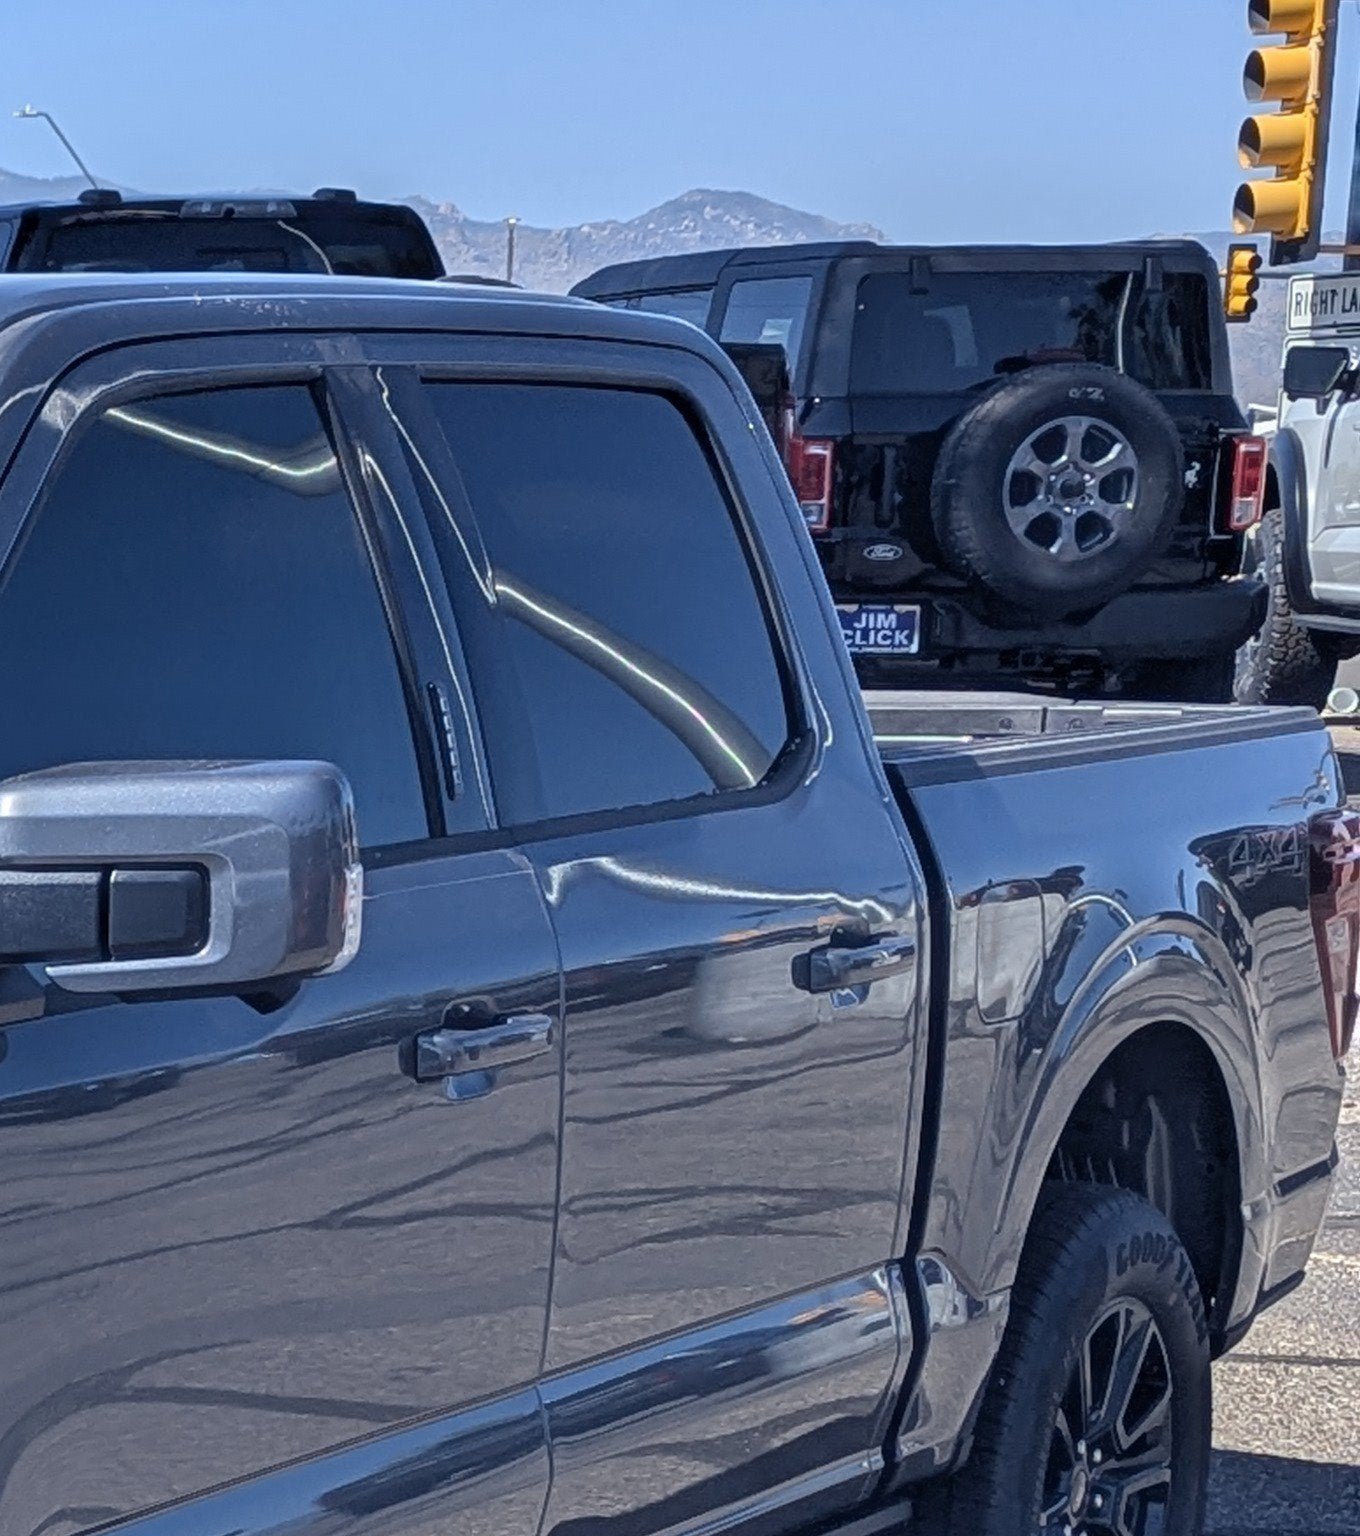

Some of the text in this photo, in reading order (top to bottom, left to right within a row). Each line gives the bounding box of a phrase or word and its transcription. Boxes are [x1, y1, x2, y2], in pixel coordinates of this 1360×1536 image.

[1294, 287, 1360, 316] RIGHT LA
[853, 613, 897, 629] JIM
[842, 630, 910, 645] CLICK
